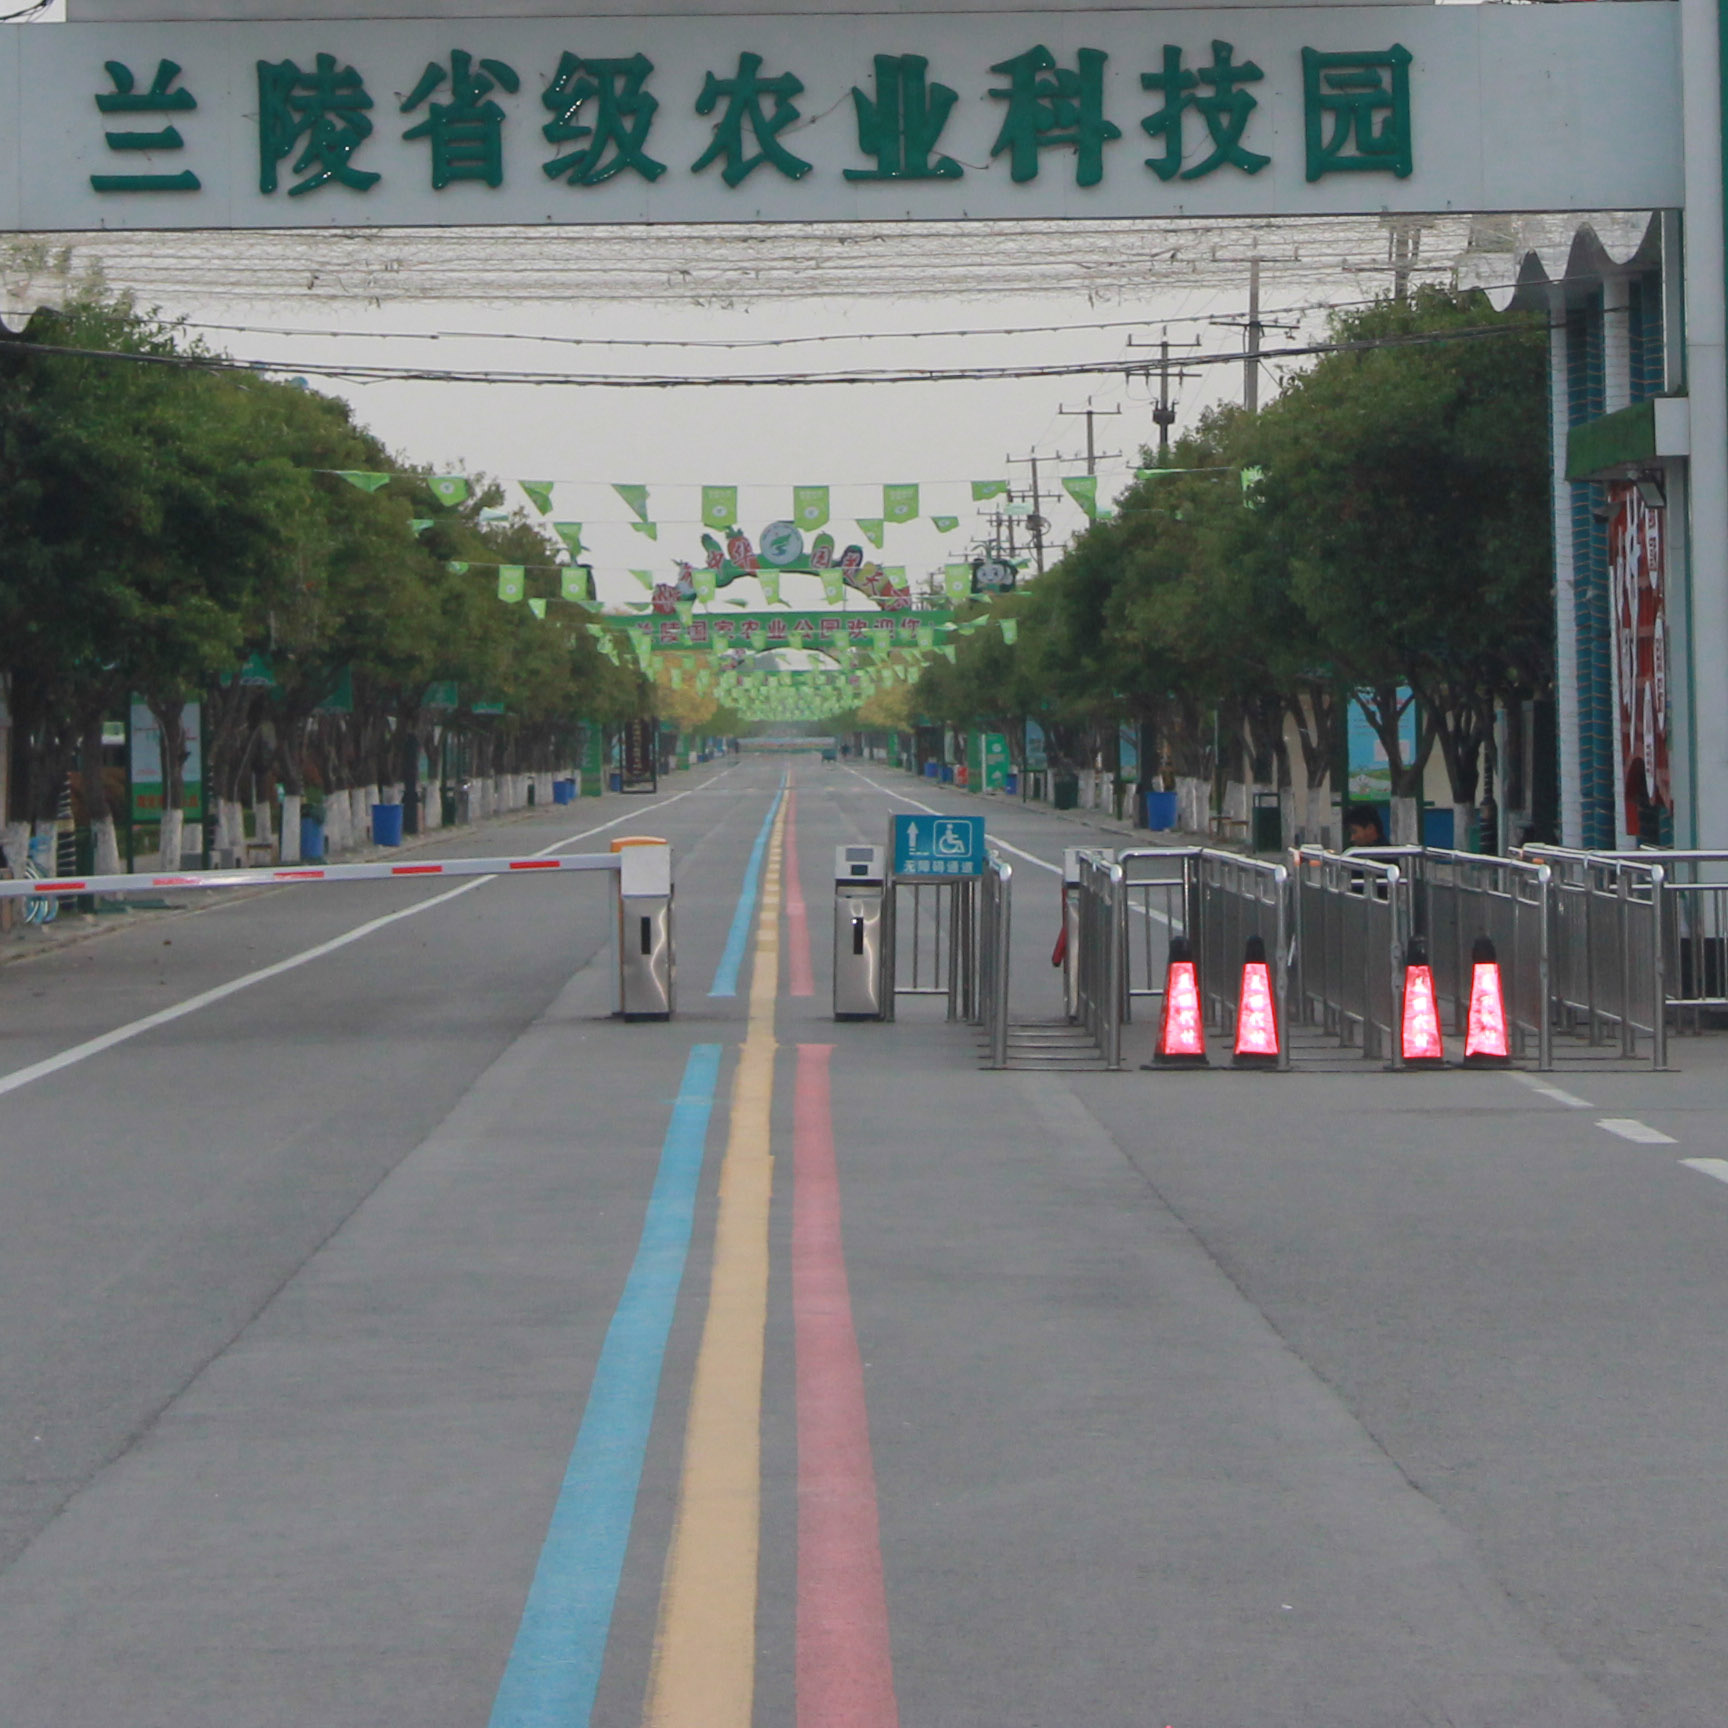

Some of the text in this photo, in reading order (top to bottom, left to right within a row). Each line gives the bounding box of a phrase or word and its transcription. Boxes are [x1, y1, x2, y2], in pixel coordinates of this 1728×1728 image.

[91, 44, 1415, 196] 兰陵省级农业科技园
